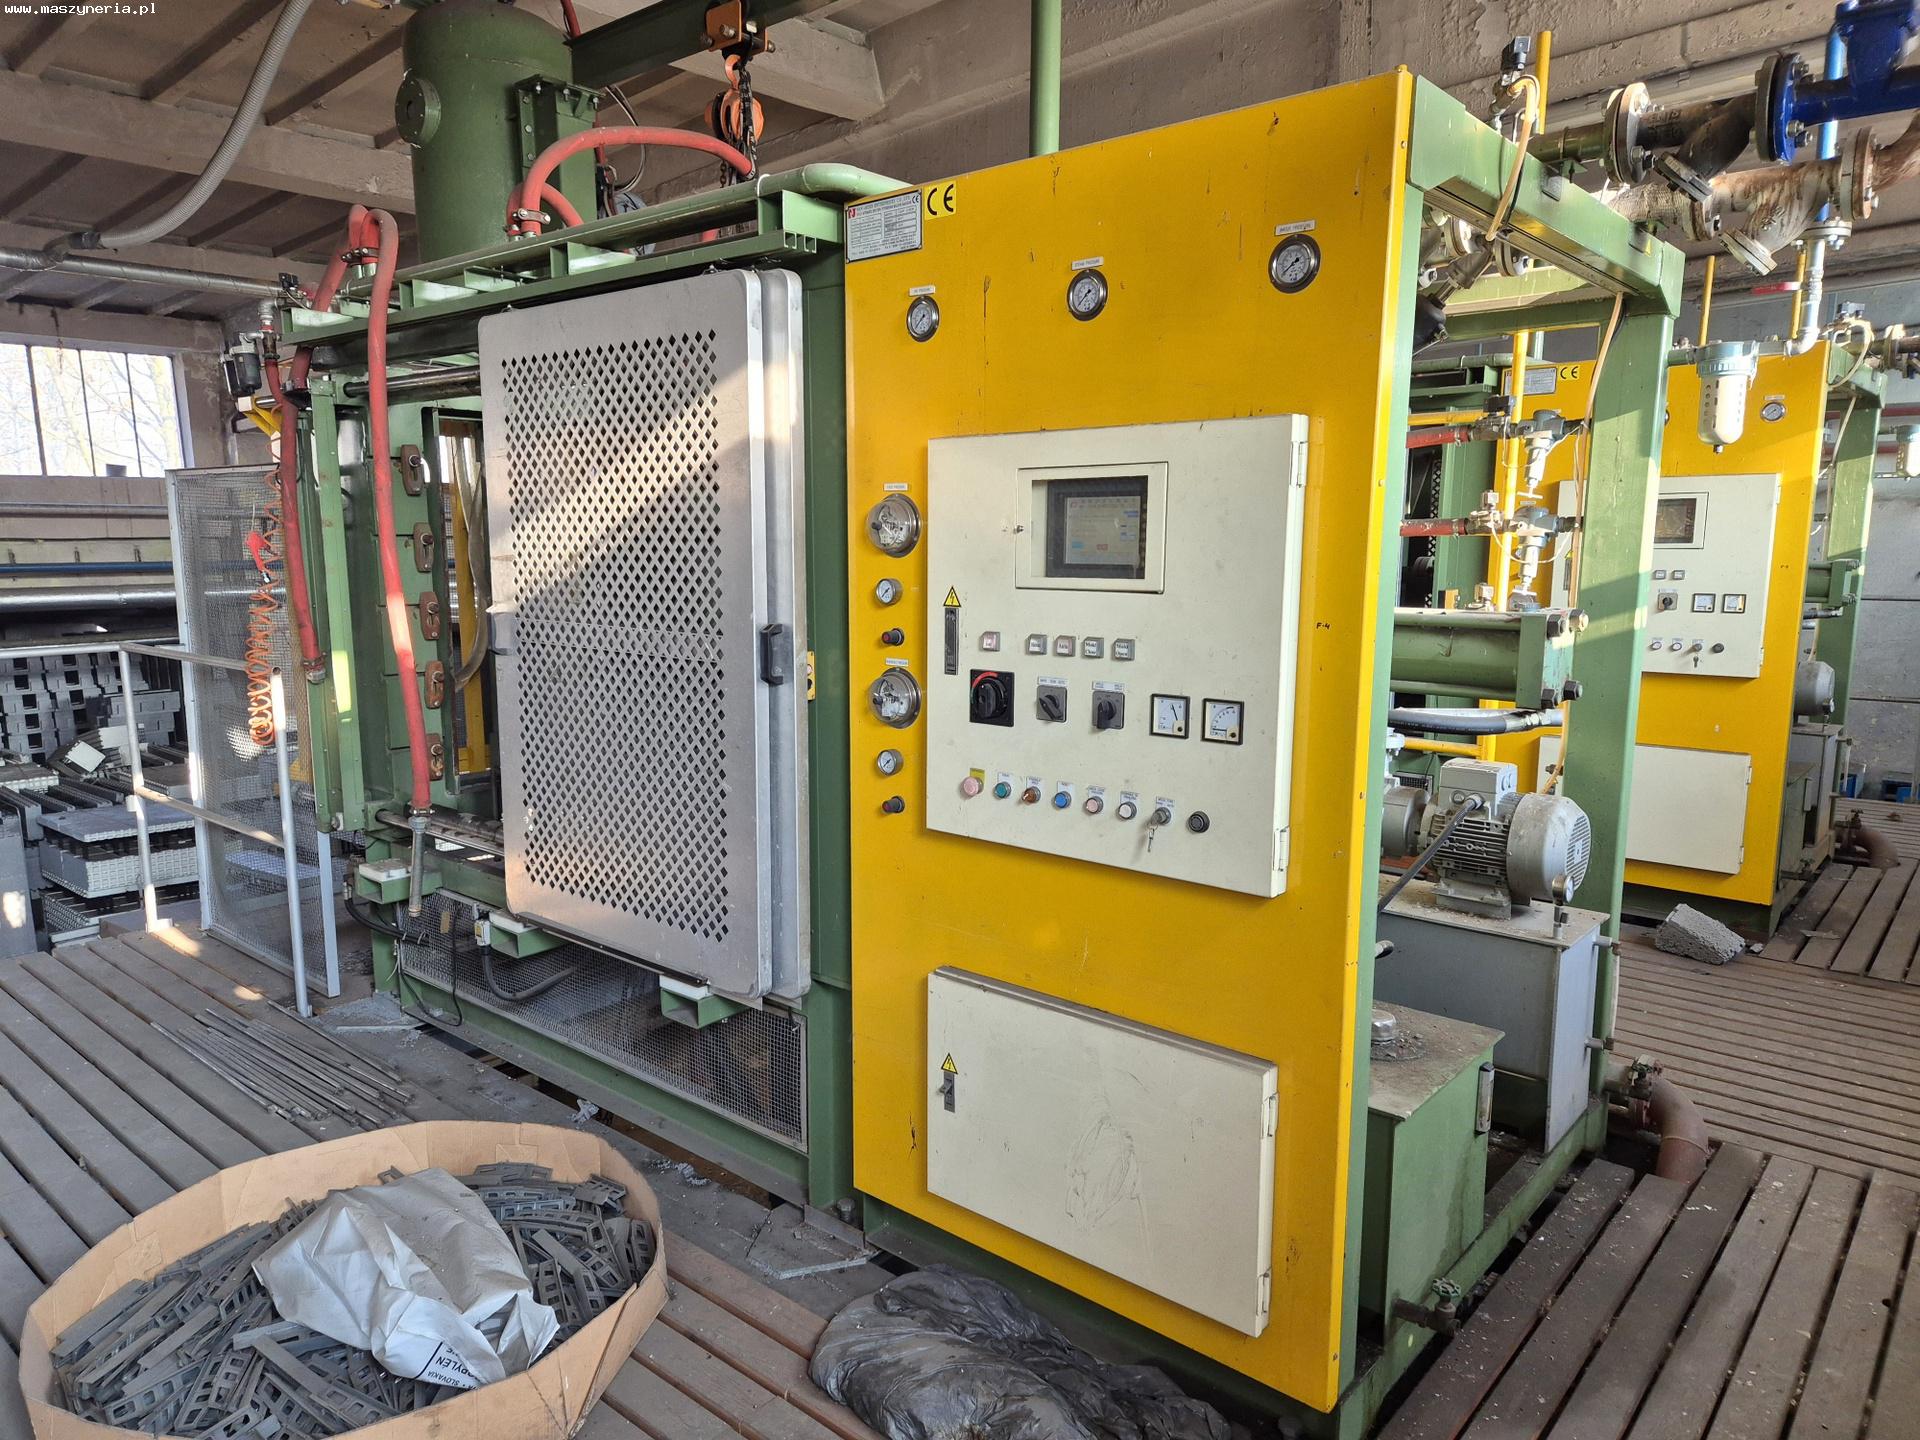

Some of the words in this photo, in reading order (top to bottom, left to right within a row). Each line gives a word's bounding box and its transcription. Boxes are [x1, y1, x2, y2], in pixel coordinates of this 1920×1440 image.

[927, 184, 954, 215] CE
[1560, 365, 1579, 379] CE
[428, 1371, 460, 1386] SLOVAKIA
